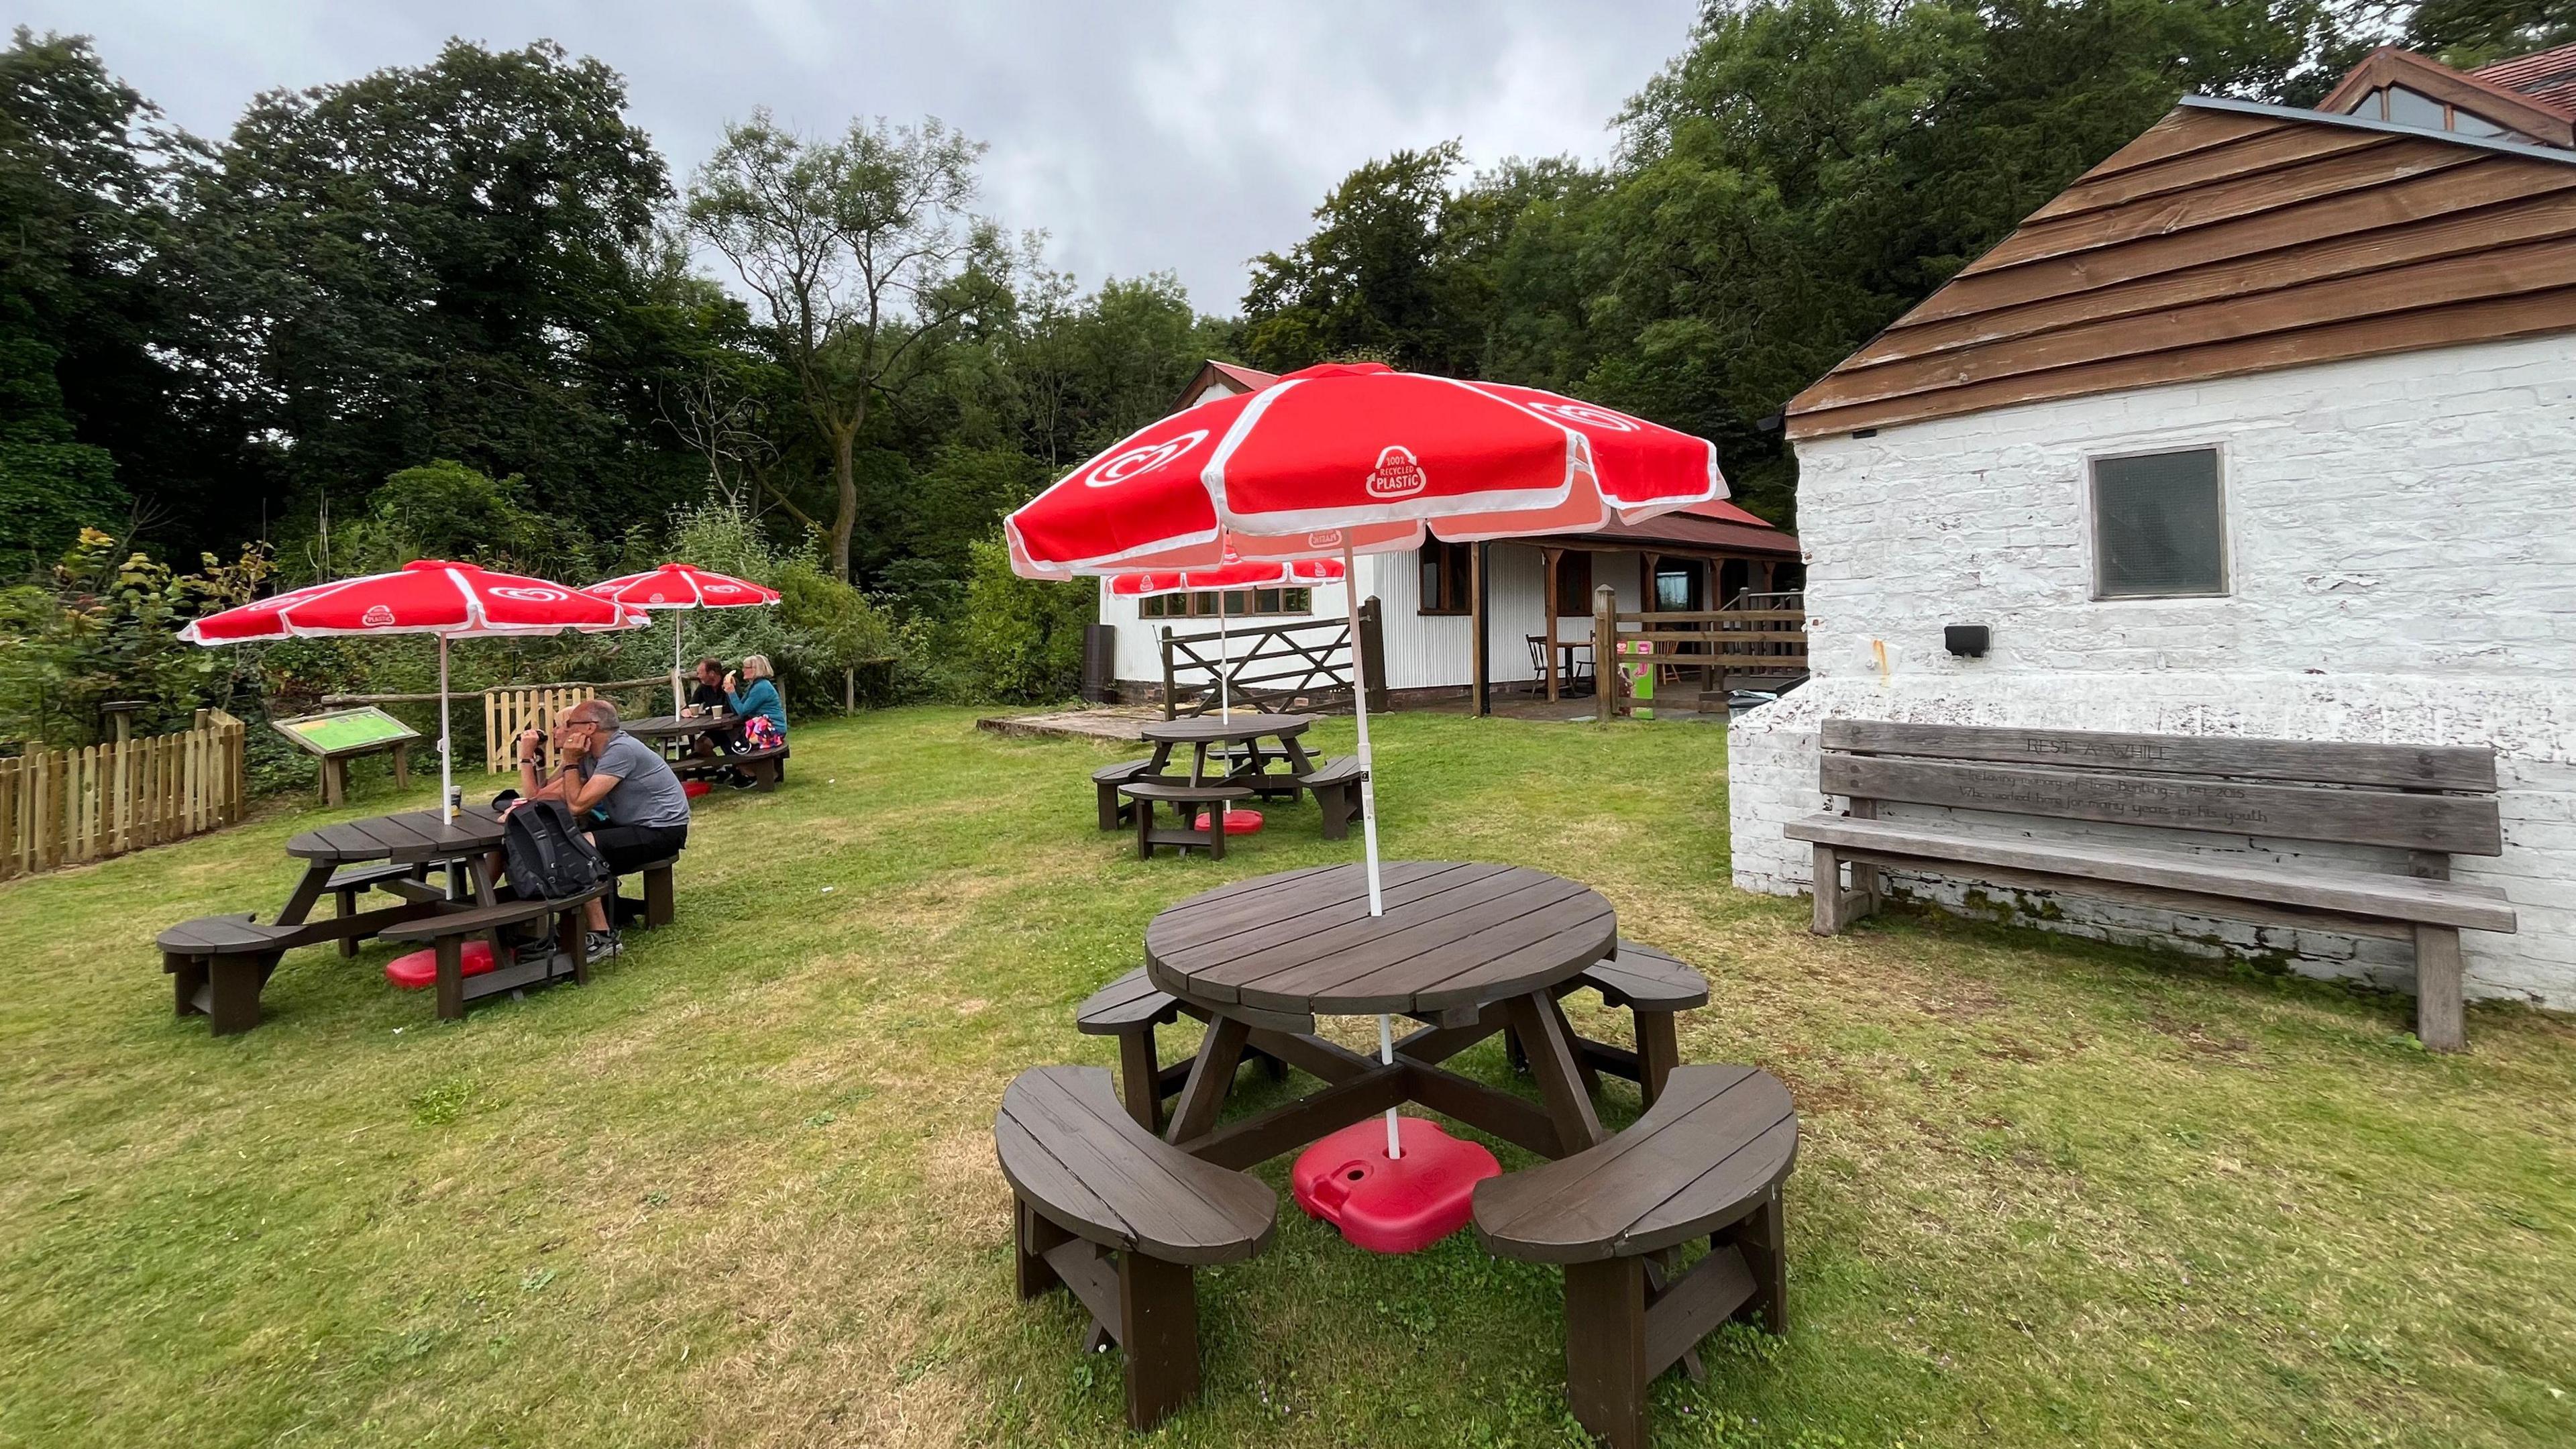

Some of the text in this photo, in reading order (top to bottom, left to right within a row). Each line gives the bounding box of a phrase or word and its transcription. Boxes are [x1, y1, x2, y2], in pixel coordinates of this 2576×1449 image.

[1386, 456, 1405, 466] 100%
[1379, 466, 1414, 476] RECYCLED
[2026, 738, 2173, 761] REST A WHILE
[1958, 786, 1986, 798] Who
[2224, 809, 2267, 826] youth
